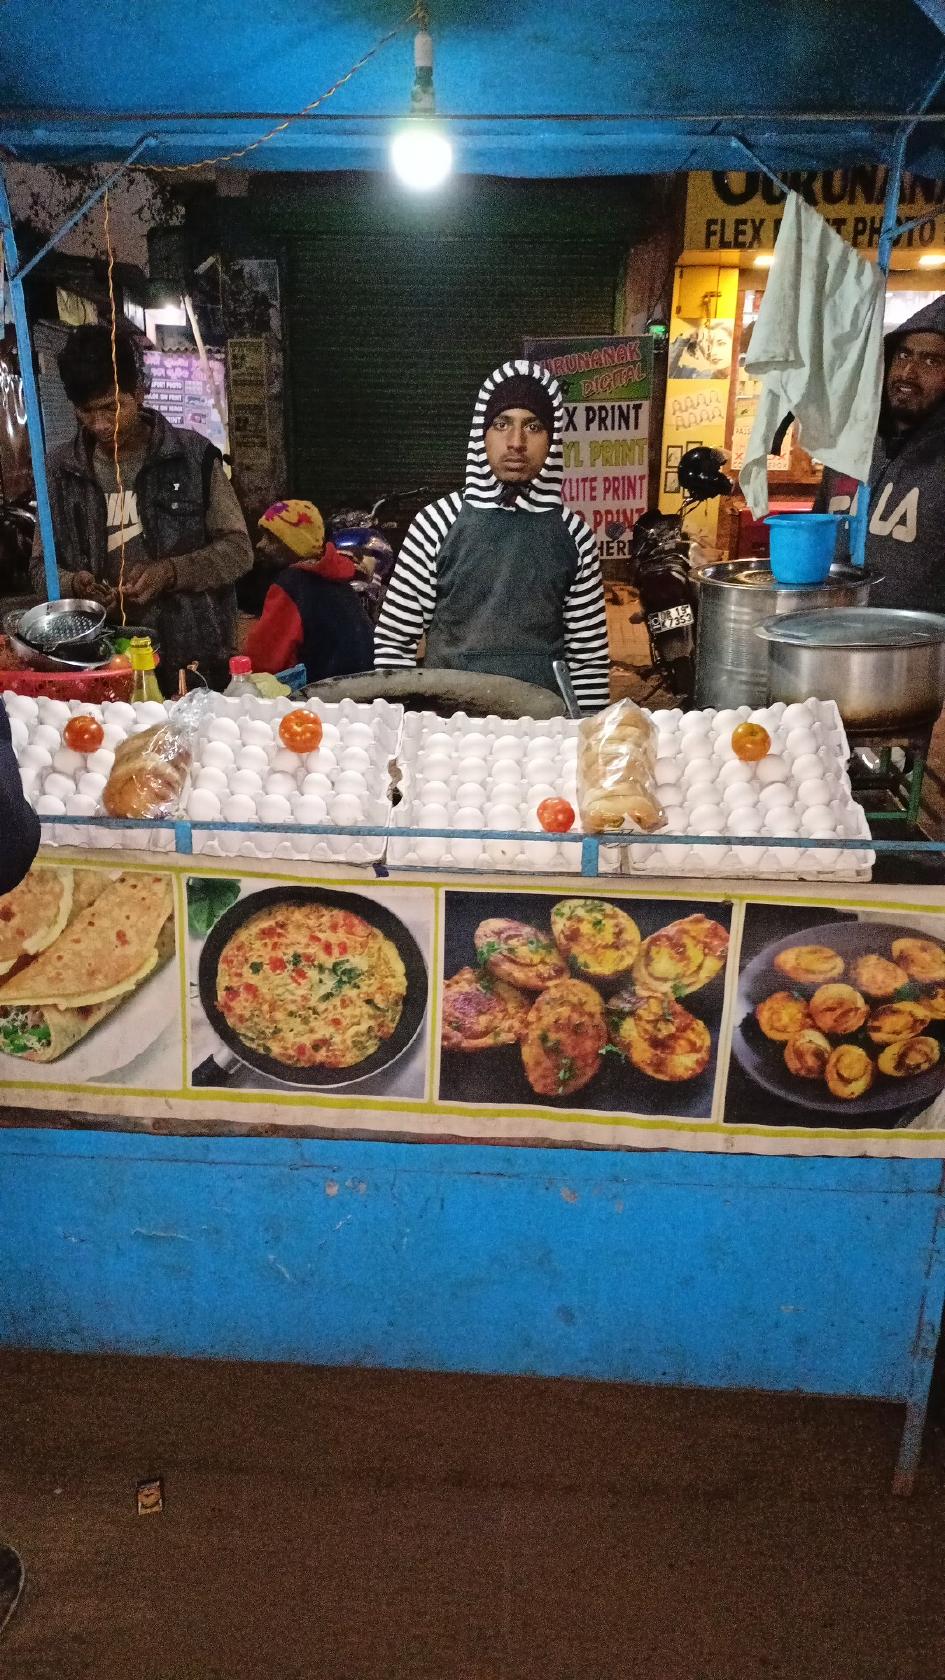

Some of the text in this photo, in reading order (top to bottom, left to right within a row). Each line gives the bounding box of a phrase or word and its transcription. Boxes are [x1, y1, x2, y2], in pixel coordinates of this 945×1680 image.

[705, 217, 766, 249] FLEX
[581, 362, 647, 398] DIGITAL
[585, 403, 643, 431] PRINT
[589, 438, 648, 466] PRINT
[603, 474, 646, 501] PRINT
